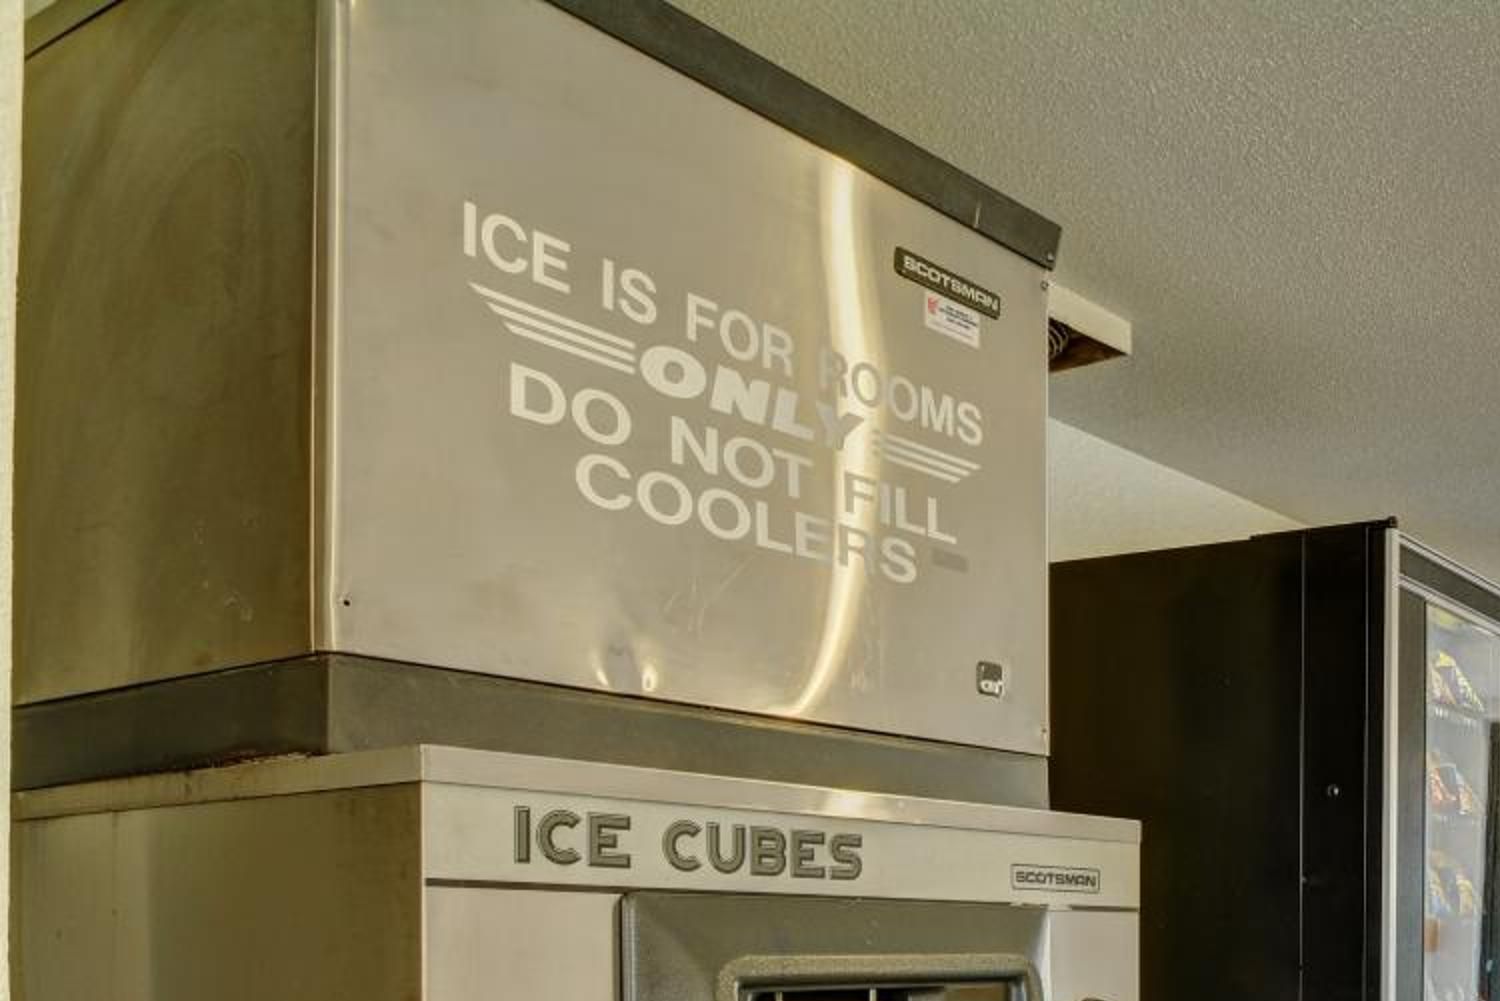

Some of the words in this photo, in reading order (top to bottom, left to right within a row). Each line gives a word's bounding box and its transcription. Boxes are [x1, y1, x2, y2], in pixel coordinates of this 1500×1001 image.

[463, 200, 571, 295] ICE
[603, 256, 658, 325] IS
[687, 291, 794, 378] FOR
[818, 350, 984, 447] ROOMS
[903, 255, 999, 312] SCOTSMAN
[640, 345, 866, 451] ONLY
[510, 361, 632, 446] DO
[671, 415, 815, 499] NOT
[844, 470, 957, 545] FILL
[575, 454, 917, 583] COOLERS
[513, 805, 632, 869] ICE
[662, 820, 864, 882] CUBES
[1015, 871, 1097, 888] SCOTSMAN
